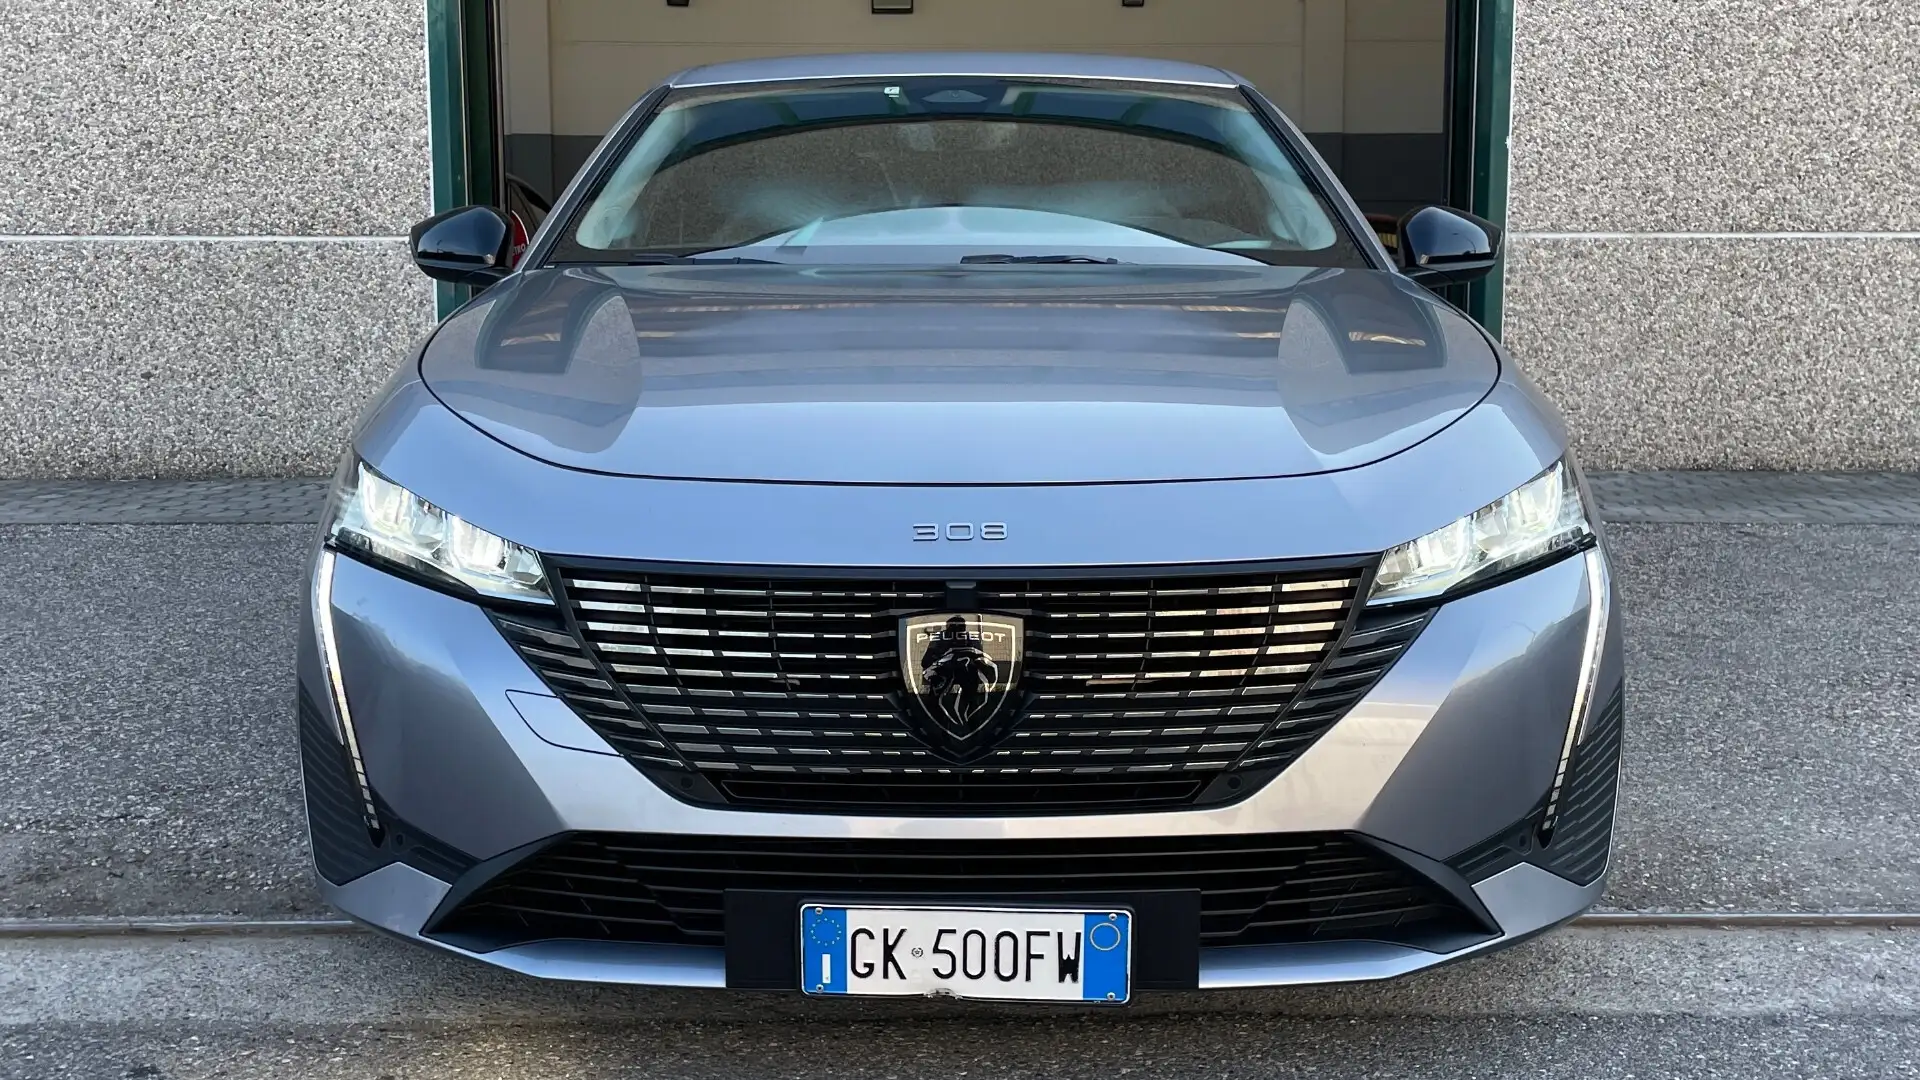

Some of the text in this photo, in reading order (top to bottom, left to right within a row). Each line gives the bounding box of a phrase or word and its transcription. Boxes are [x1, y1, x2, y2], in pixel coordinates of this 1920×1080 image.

[912, 522, 1008, 541] 308
[916, 631, 1006, 643] PEUGEOT
[850, 927, 1082, 984] GK 500FW
